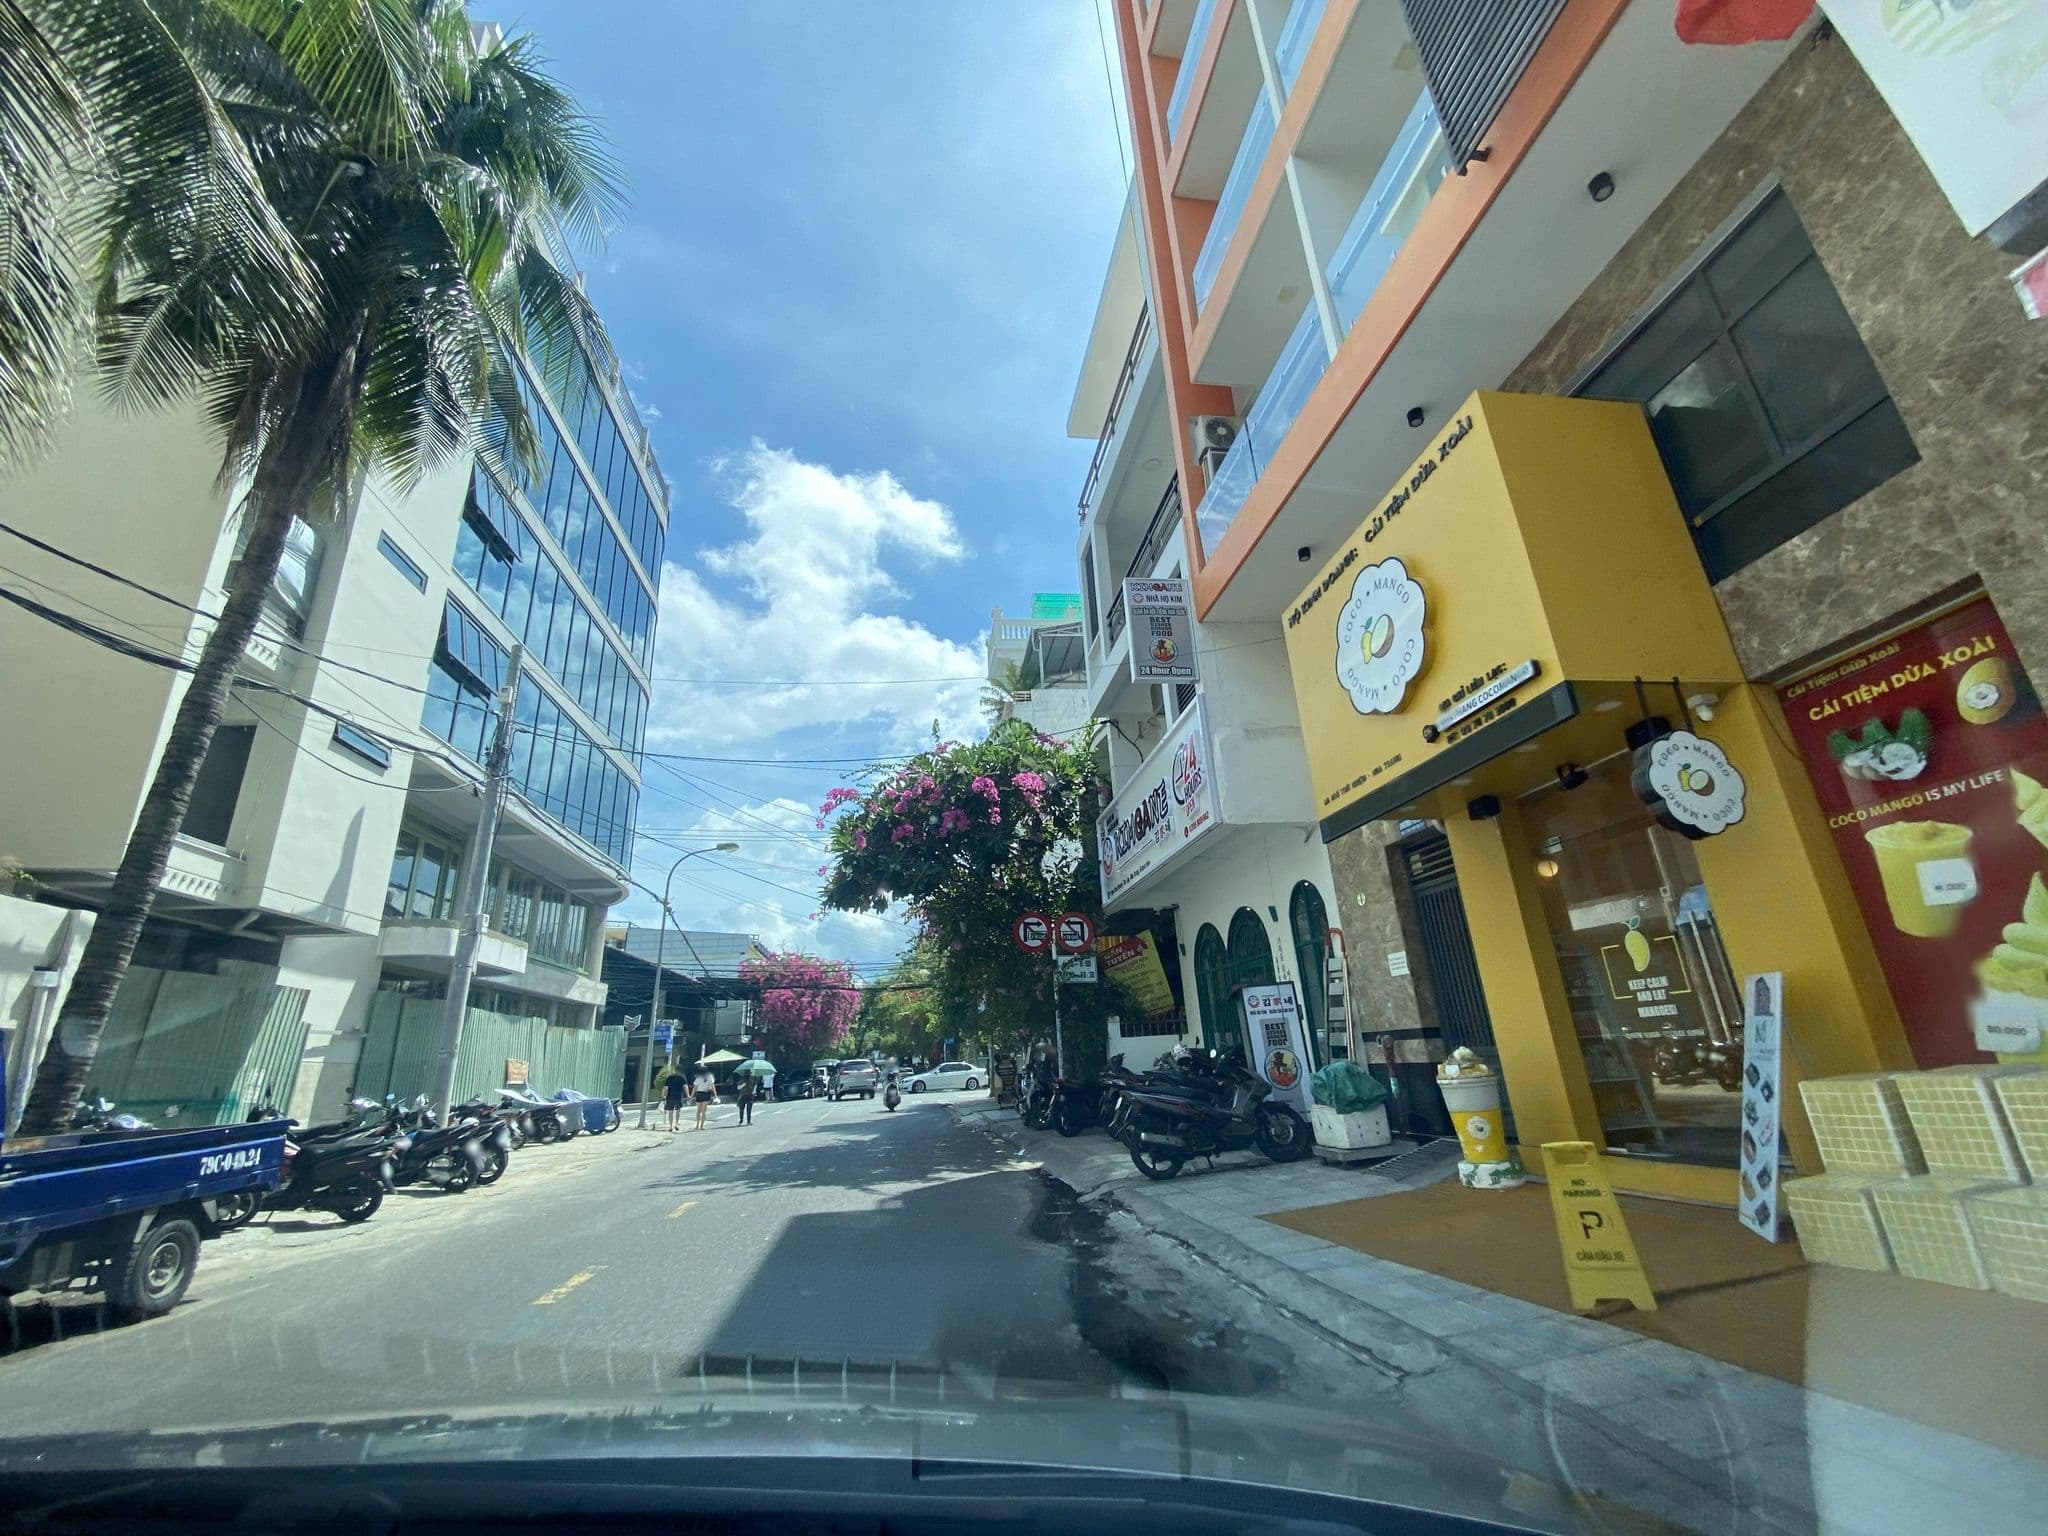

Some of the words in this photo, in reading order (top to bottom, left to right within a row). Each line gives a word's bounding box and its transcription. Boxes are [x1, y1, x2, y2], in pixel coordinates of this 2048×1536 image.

[1344, 598, 1363, 643] COCO
[1373, 577, 1410, 604] MANGO
[1140, 666, 1151, 675] 24
[1151, 666, 1170, 676] Hour
[1171, 666, 1192, 676] Open
[1391, 638, 1415, 687] COCO
[1808, 698, 1841, 721] CÁI
[1841, 680, 1890, 707] TIỆM
[1889, 661, 1937, 689] DỪA
[1937, 635, 1996, 670] XOÀI
[1347, 668, 1379, 701] MANGO
[1658, 743, 1680, 767] COCO
[1692, 743, 1729, 777] MANGO
[1661, 784, 1700, 820] MANGO
[1712, 798, 1737, 822] COCO
[1829, 809, 1867, 829] COCO
[1868, 793, 1924, 818] MANGO
[1924, 787, 1941, 803] IS
[1941, 779, 1968, 797] MY
[1968, 769, 2006, 790] LIFE
[1264, 1022, 1286, 1031] BEST
[1563, 1188, 1602, 1199] PARKING
[1571, 1178, 1586, 1188] NO
